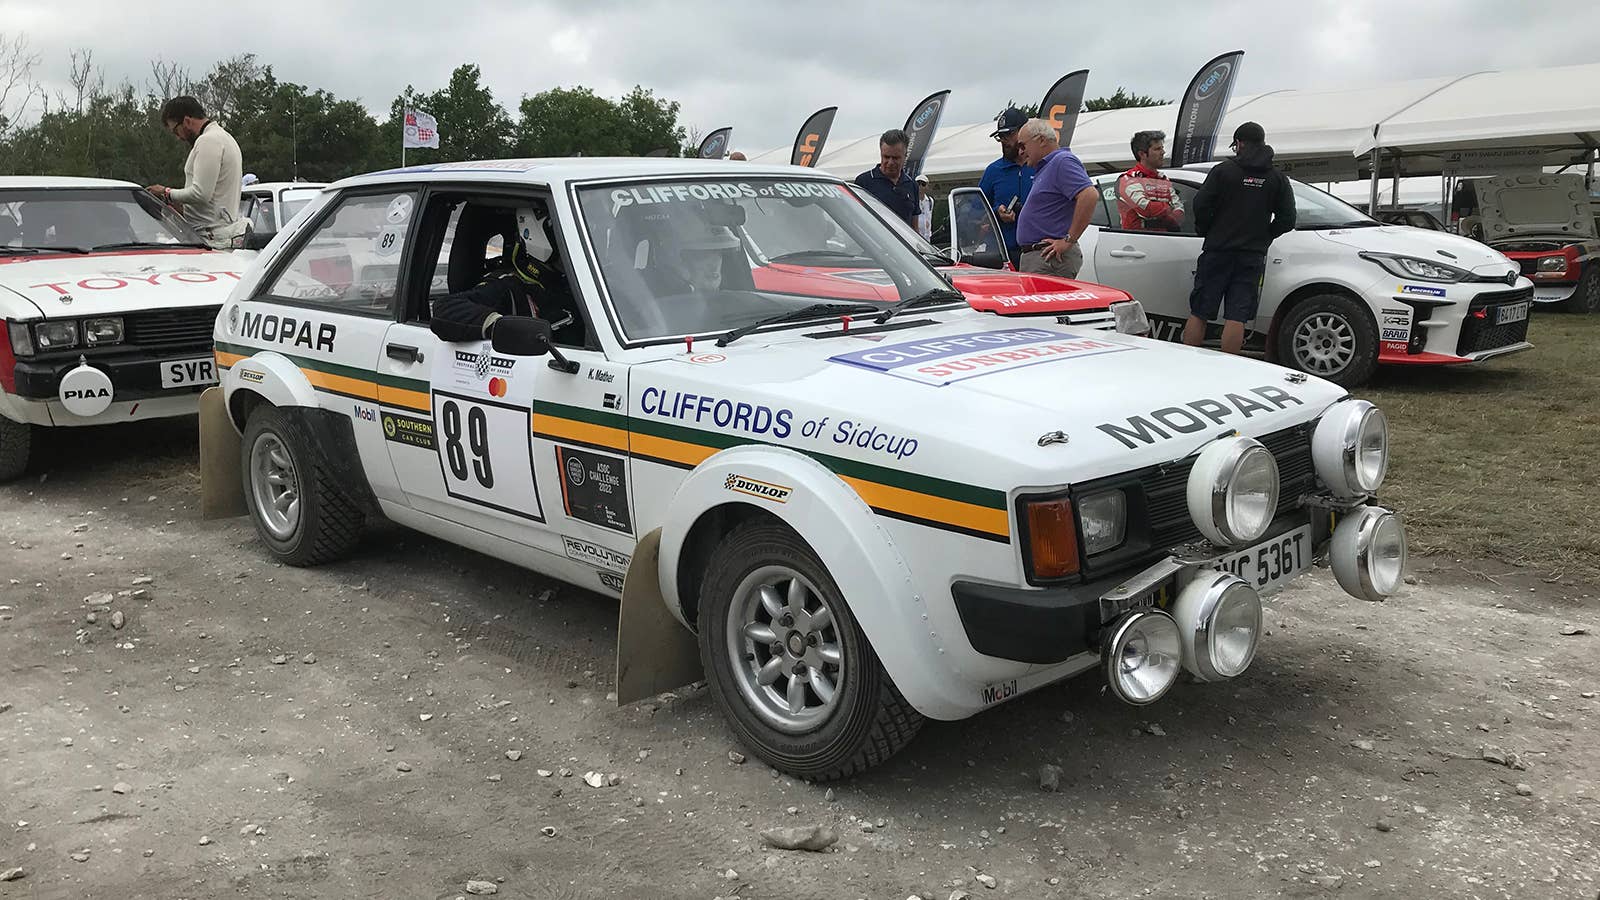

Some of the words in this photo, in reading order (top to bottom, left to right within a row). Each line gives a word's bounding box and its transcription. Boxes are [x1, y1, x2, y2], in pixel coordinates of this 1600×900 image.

[1200, 71, 1220, 93] BGM
[916, 106, 933, 124] BGM
[611, 183, 758, 212] CLIFFORDS
[759, 186, 775, 197] of
[381, 233, 396, 248] 89
[240, 311, 337, 353] MOPAR
[1382, 330, 1408, 339] BRAID
[917, 339, 1113, 377] SUNBEAM
[170, 360, 212, 384] SVR
[587, 368, 594, 380] K.
[595, 369, 615, 383] Mather
[64, 387, 111, 400] PIAA
[354, 405, 377, 422] Mobil
[641, 387, 793, 439] CLIFFORDS
[801, 417, 829, 439] of
[833, 421, 919, 460] Sidcup
[1096, 385, 1304, 450] MOPAR
[397, 418, 433, 434] SOUTHERN
[402, 434, 414, 442] CAR
[416, 437, 432, 446] CLUB
[443, 400, 495, 489] 89
[589, 470, 620, 487] CHALLENGE
[736, 479, 788, 498] DUNLOP
[566, 539, 632, 566] REVOLUTION
[1257, 531, 1305, 586] 536T
[980, 679, 1018, 705] Mobil
